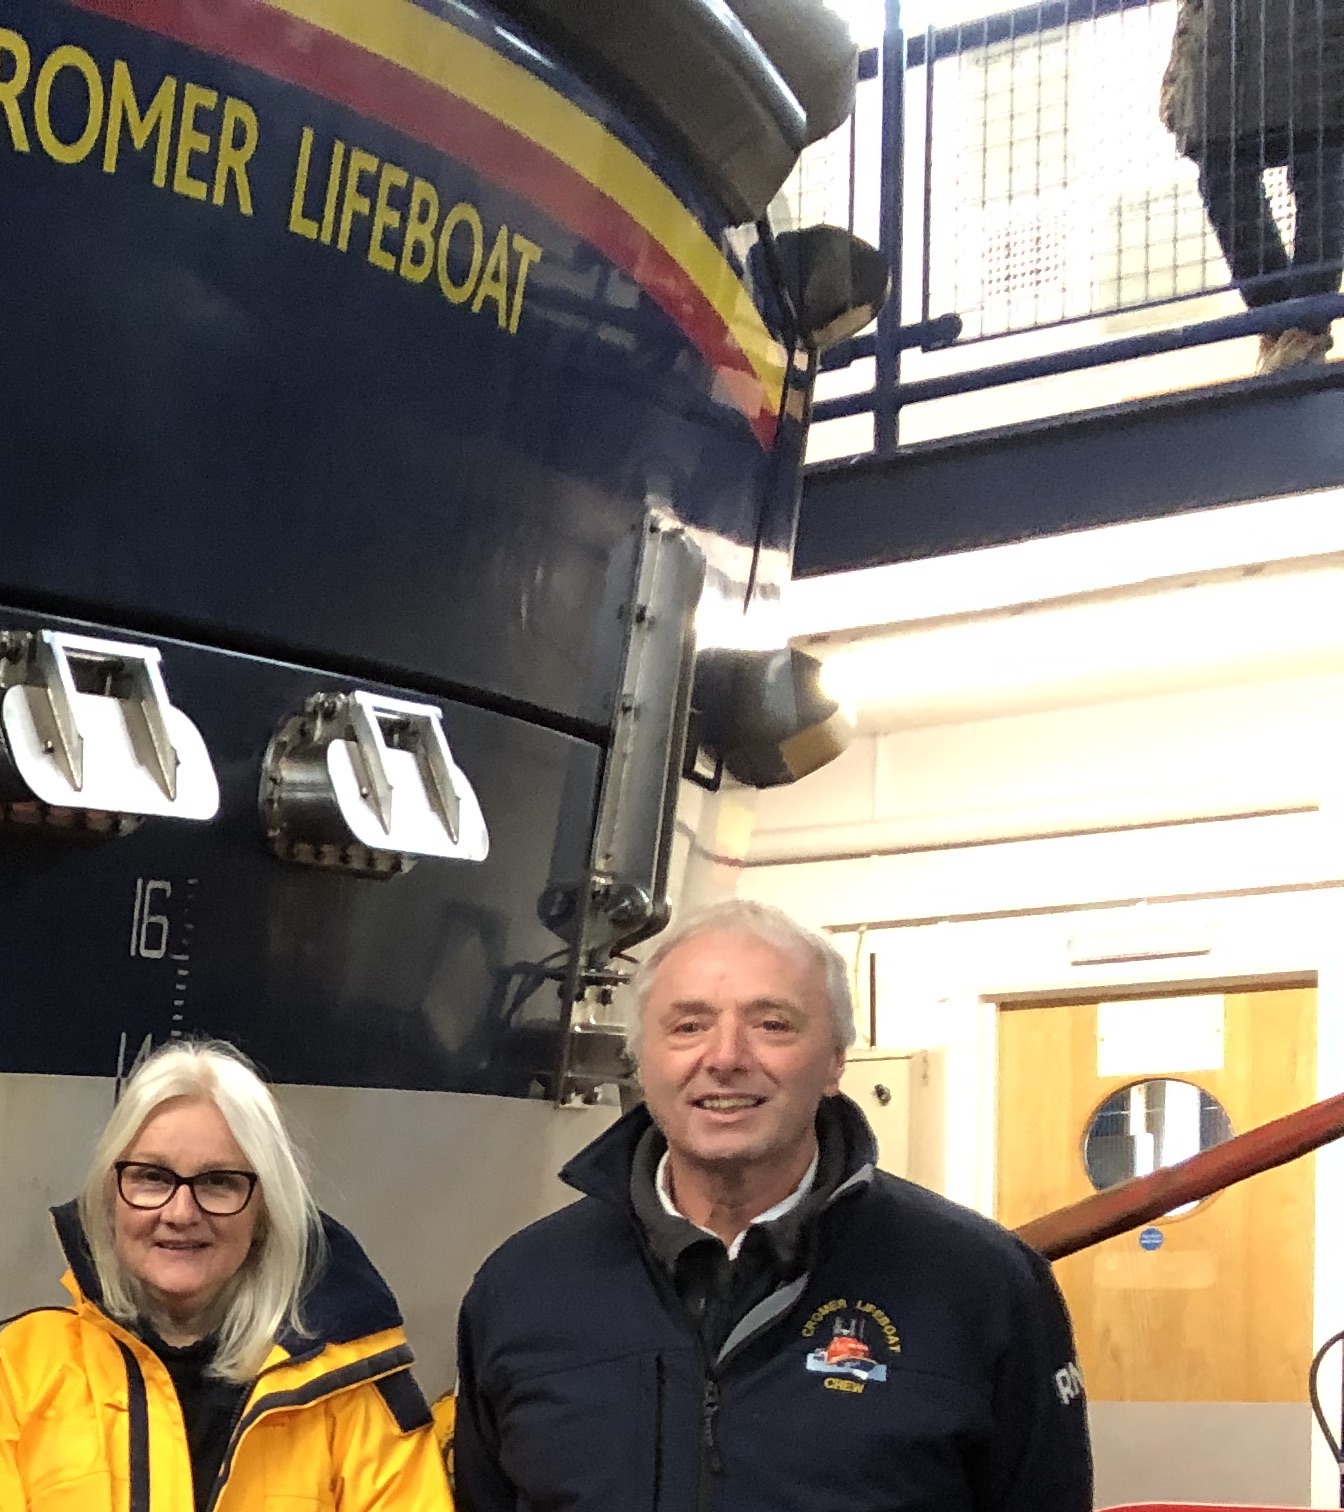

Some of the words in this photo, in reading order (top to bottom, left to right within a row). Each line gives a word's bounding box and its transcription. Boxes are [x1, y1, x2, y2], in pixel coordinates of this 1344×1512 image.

[288, 126, 543, 335] LIFEBOAT
[130, 876, 172, 960] 16
[801, 1298, 848, 1338] CROMER
[855, 1299, 902, 1353] LIFEBOAT
[823, 1376, 866, 1394] CREW
